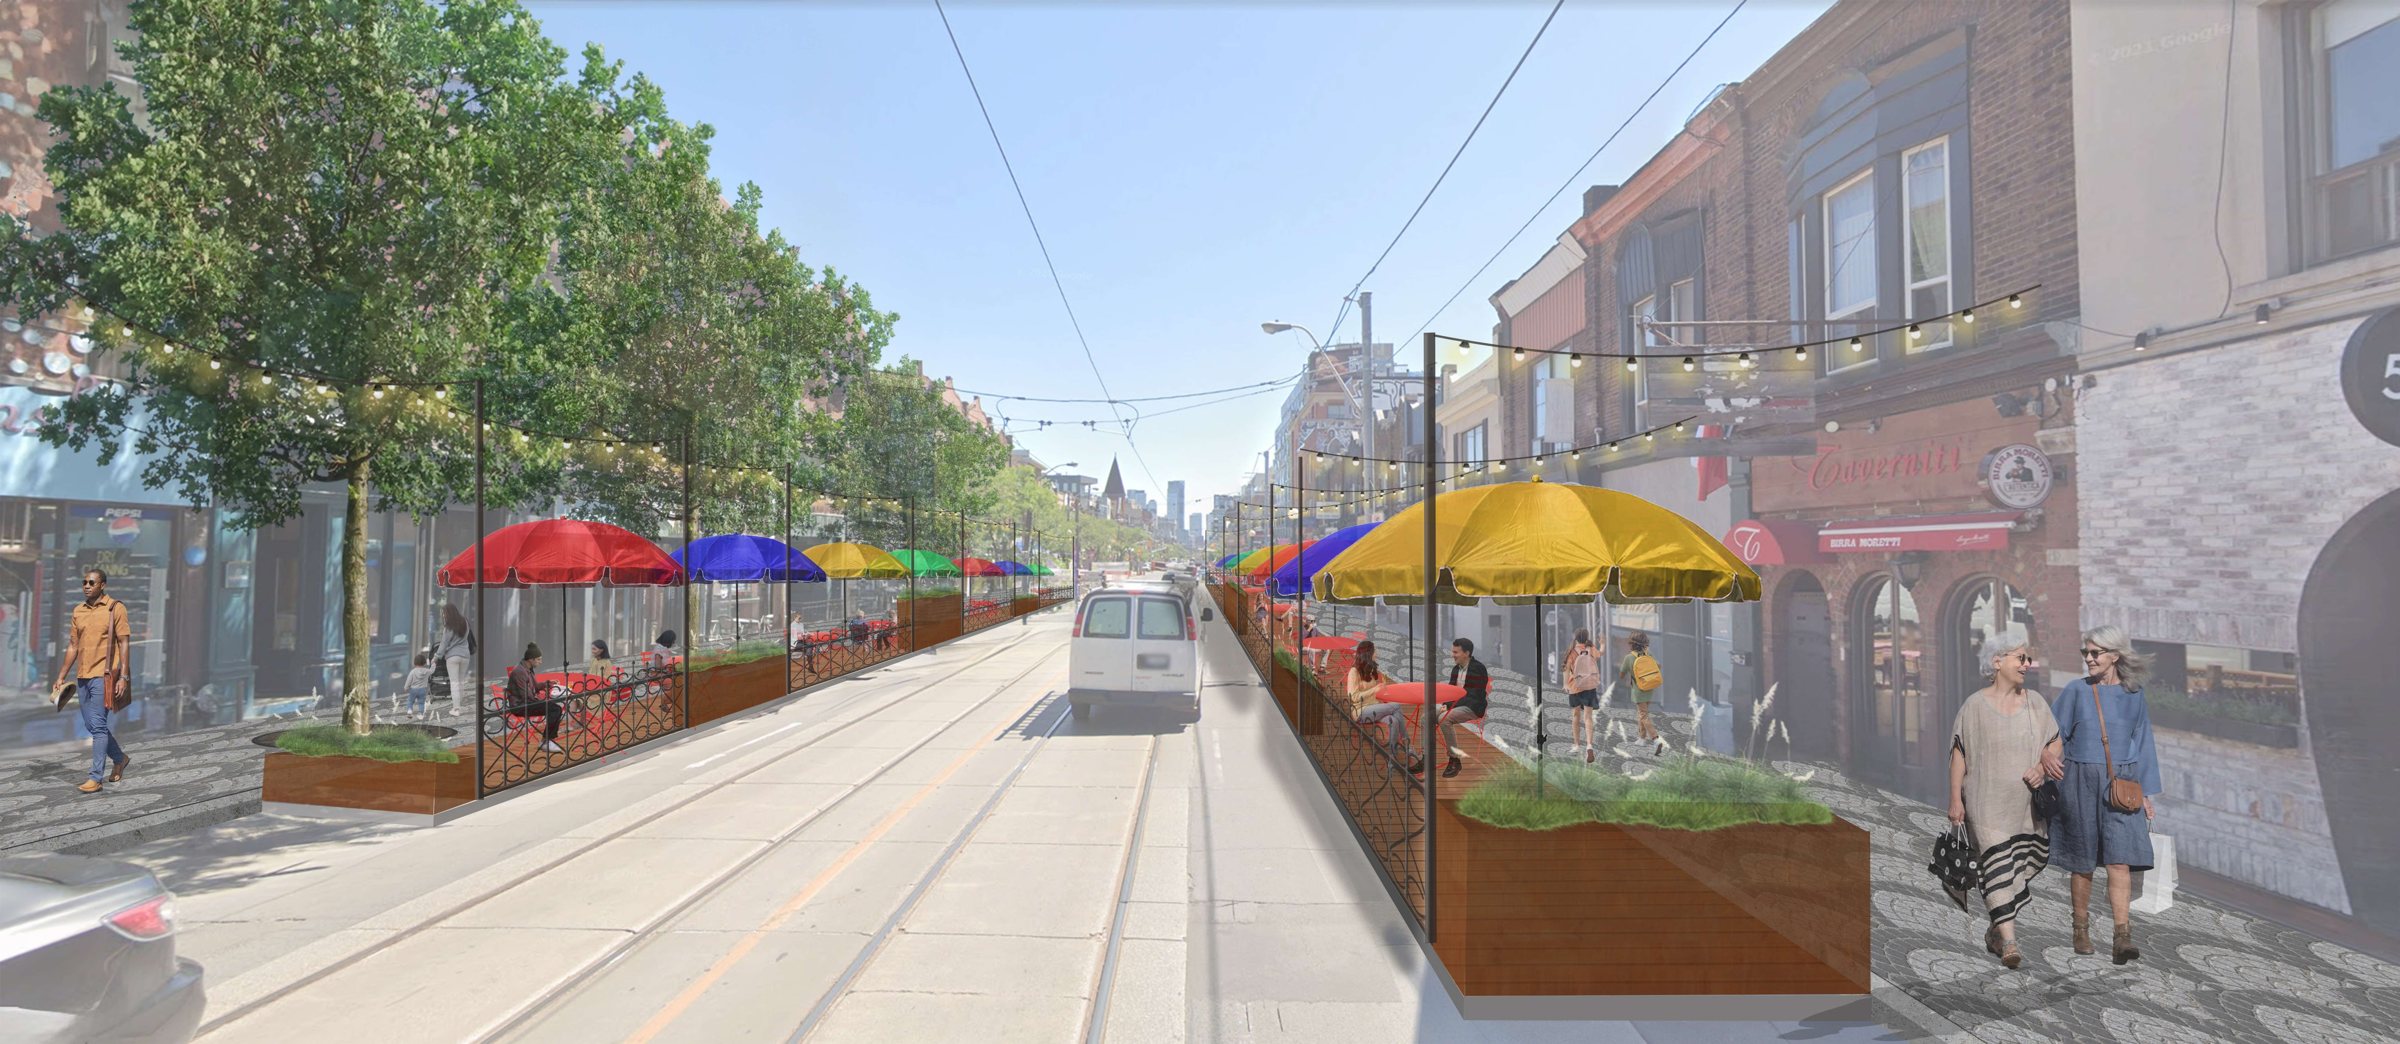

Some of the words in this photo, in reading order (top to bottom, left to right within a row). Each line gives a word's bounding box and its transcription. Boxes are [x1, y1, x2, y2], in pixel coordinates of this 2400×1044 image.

[1791, 436, 1962, 491] Taverniti
[1992, 452, 2014, 480] BIRRA
[2013, 448, 2049, 478] MORETTI
[105, 508, 142, 518] PEPSI
[1830, 538, 1856, 548] BIRRA
[1859, 537, 1901, 548] MORETTI
[97, 550, 116, 564] DRY
